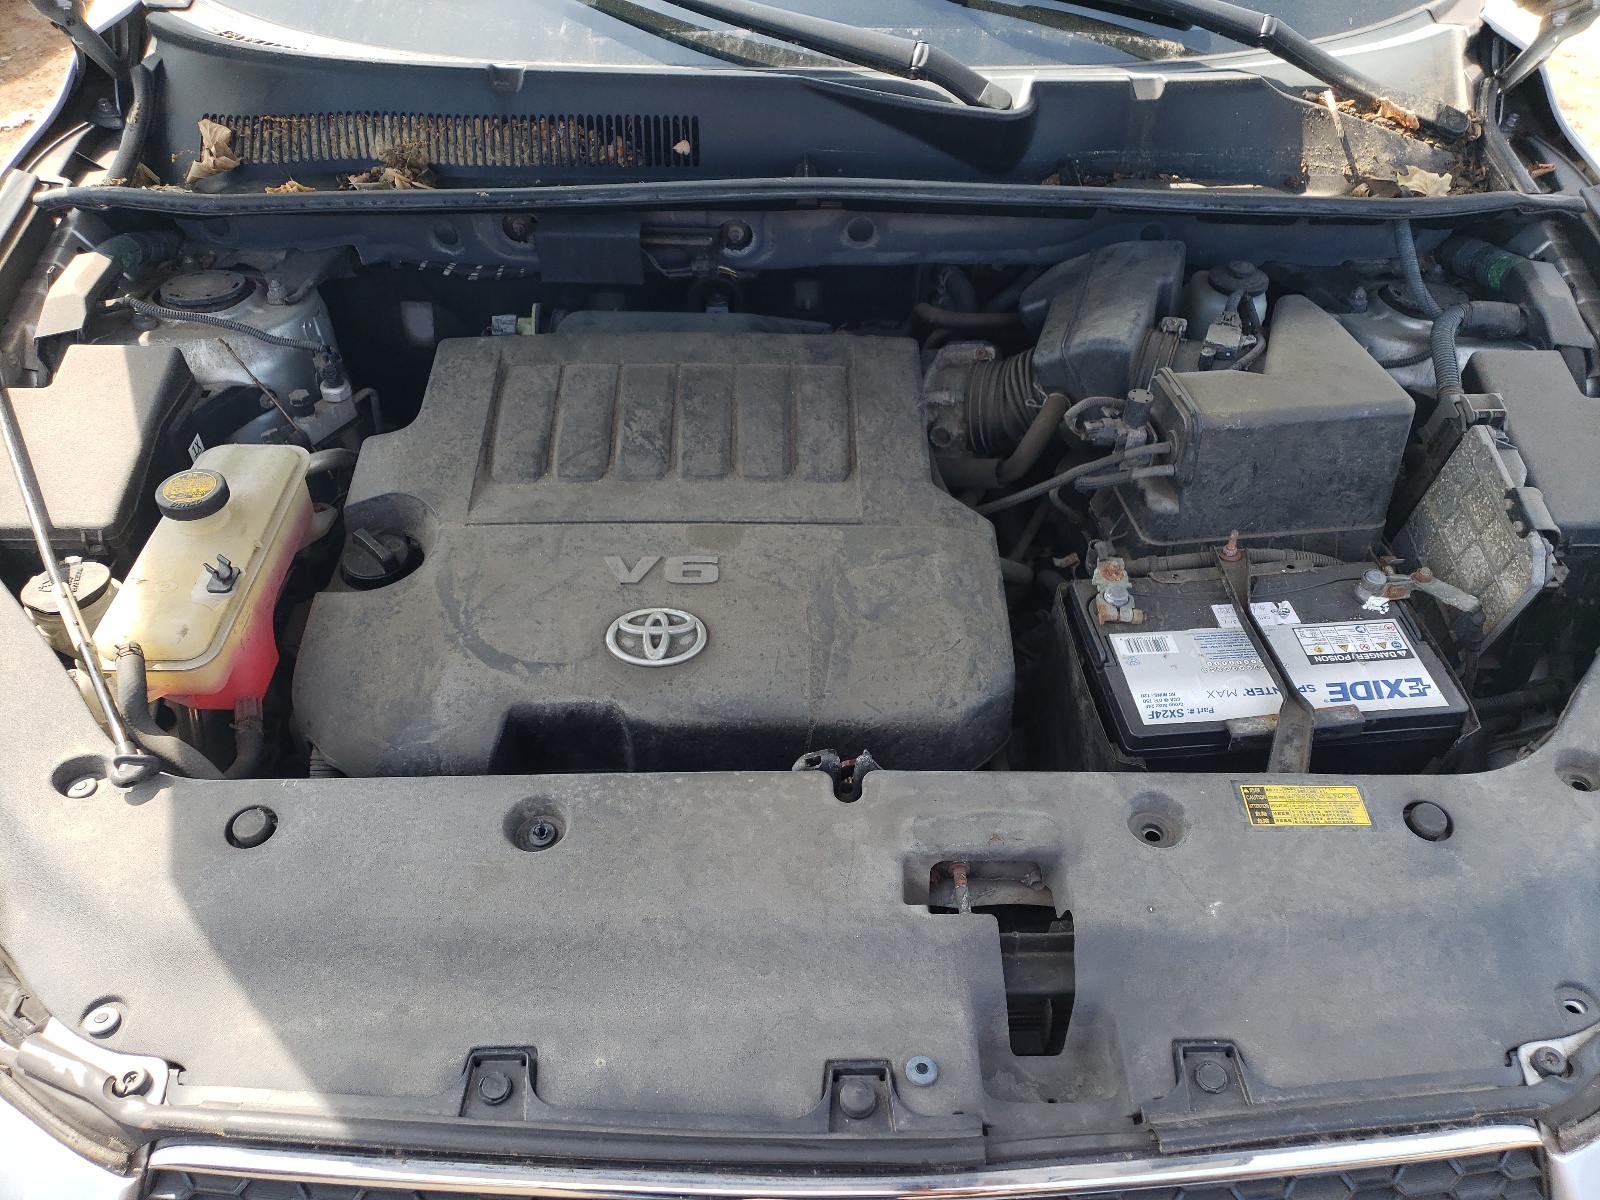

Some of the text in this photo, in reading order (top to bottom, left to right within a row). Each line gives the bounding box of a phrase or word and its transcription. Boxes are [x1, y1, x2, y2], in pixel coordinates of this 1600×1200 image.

[602, 555, 720, 585] V6
[1206, 684, 1316, 699] SPNTER MAX
[1325, 677, 1431, 703] EXIDE
[1148, 708, 1185, 720] SX24F
